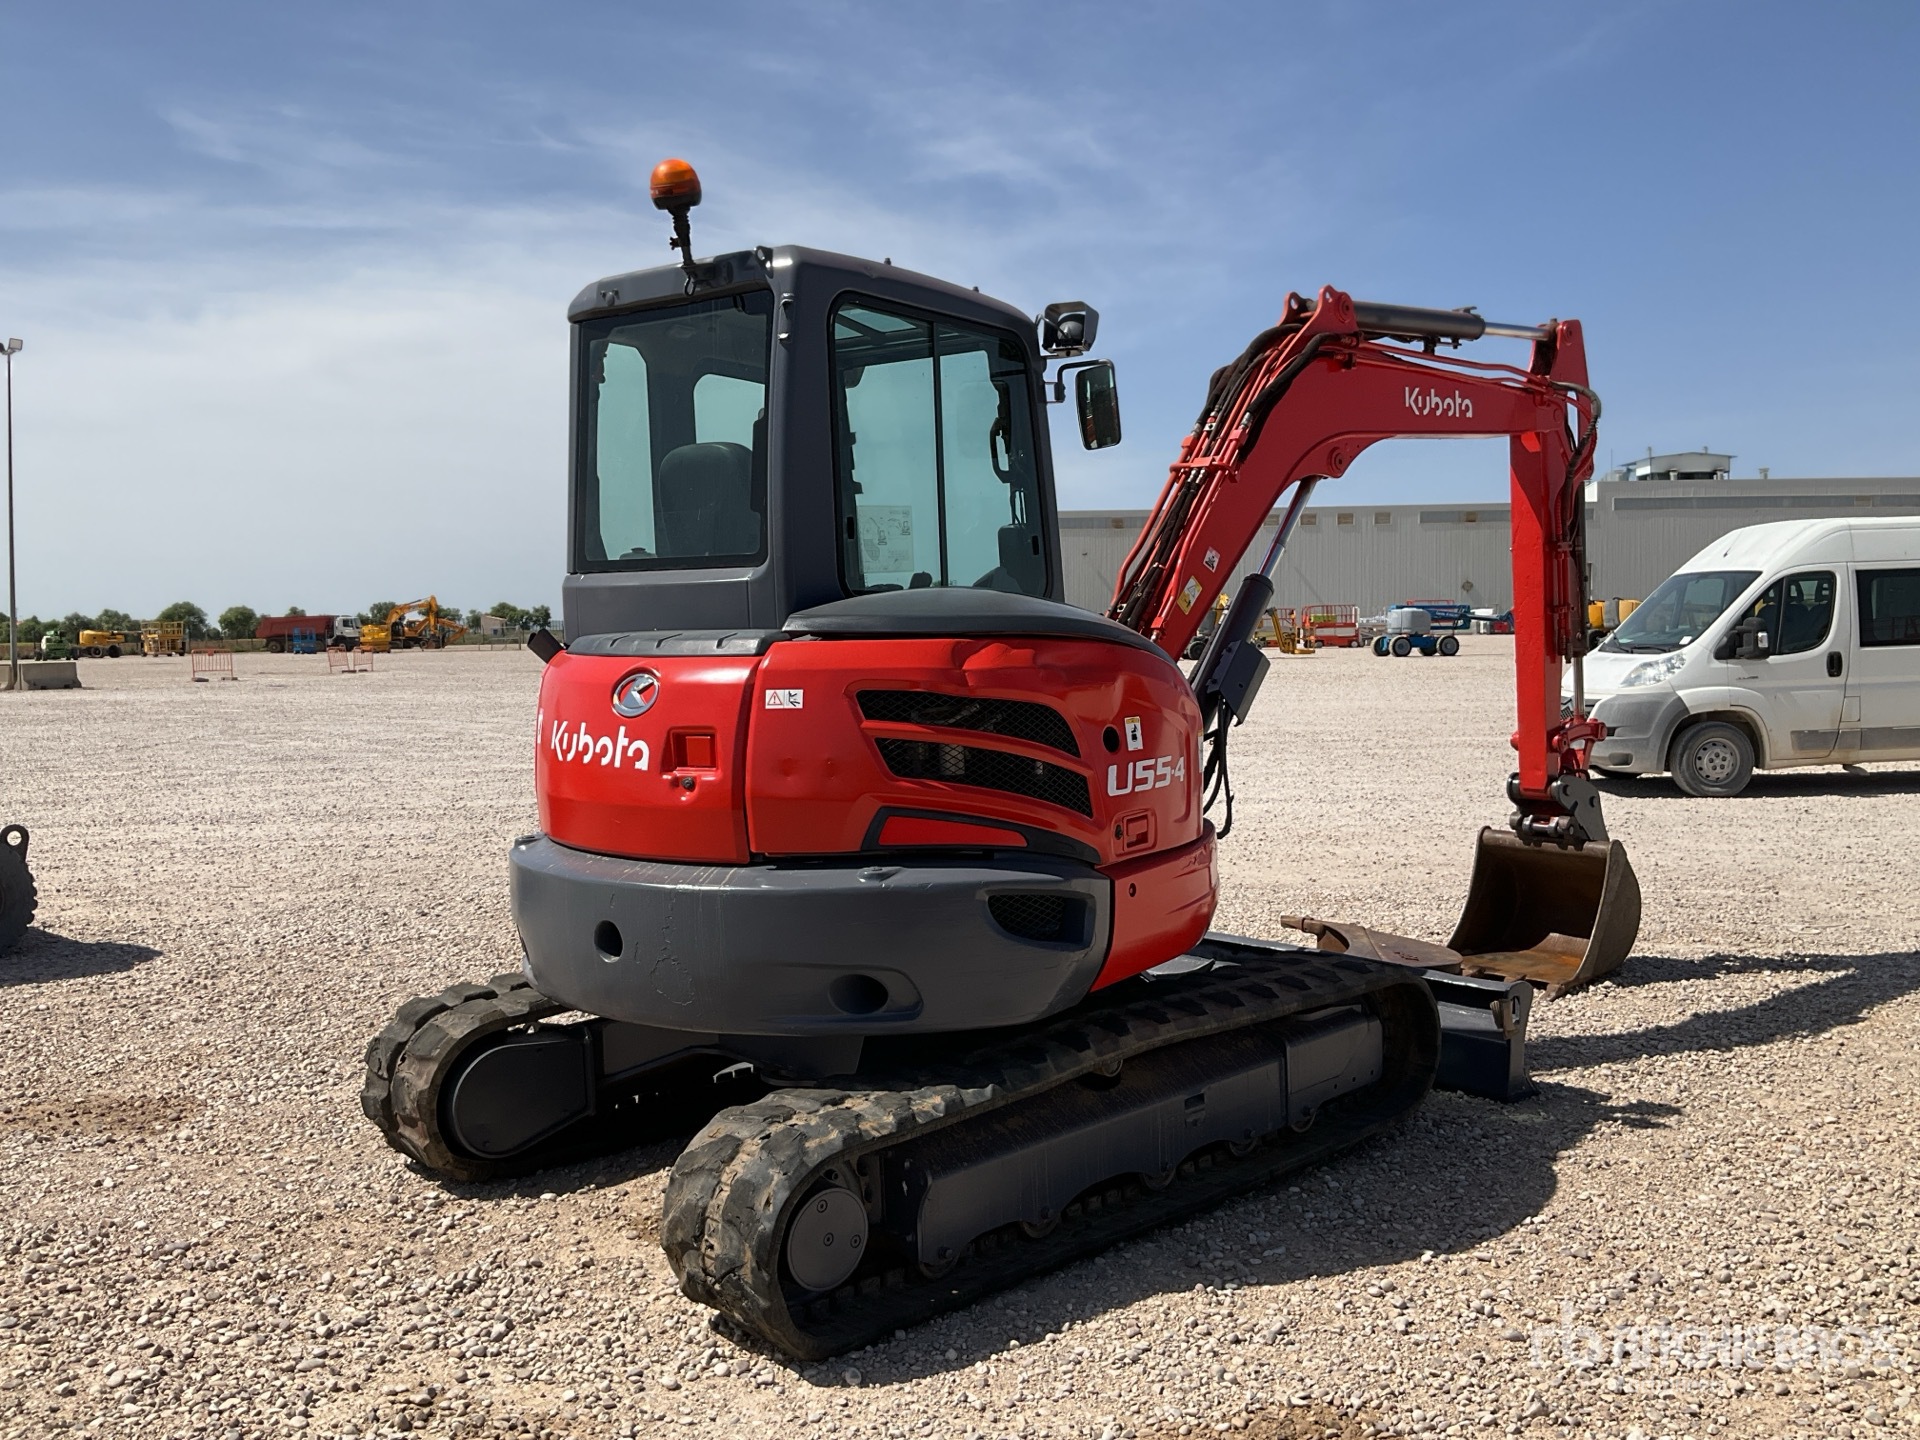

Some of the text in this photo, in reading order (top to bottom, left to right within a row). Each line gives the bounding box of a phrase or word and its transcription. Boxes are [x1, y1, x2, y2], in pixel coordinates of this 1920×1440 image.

[1404, 386, 1473, 418] Kubota
[551, 720, 650, 771] Kubota
[1107, 756, 1185, 797] U55-4
